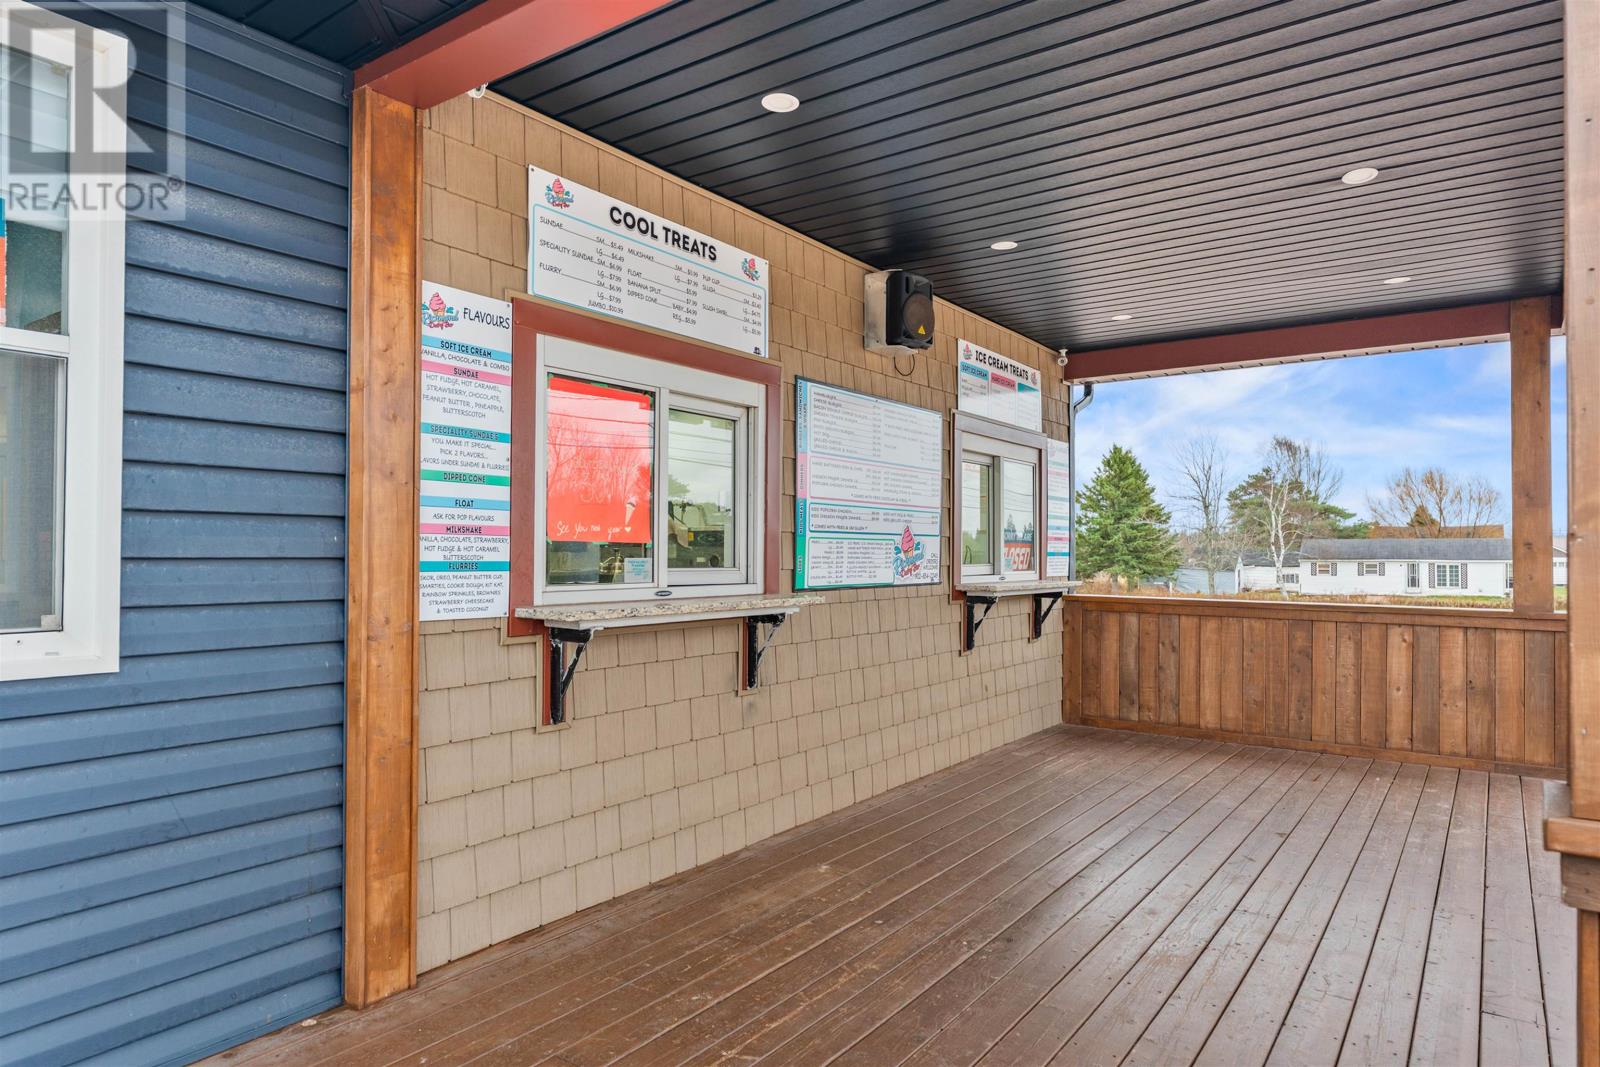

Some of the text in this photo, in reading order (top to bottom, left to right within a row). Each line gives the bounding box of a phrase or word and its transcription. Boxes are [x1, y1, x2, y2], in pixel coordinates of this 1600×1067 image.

[540, 216, 563, 229] SUNDAE
[609, 206, 717, 261] COOL TREATS
[540, 262, 562, 274] FLURRY
[627, 269, 642, 279] FLOAT
[463, 307, 511, 330] FLAVOURS
[440, 340, 492, 358] SOFT ICE CREAM
[447, 353, 482, 366] CHOCOLATE
[490, 363, 510, 371] COMBO
[975, 350, 987, 365] ICE
[988, 355, 1009, 373] CREAM
[1009, 364, 1029, 381] TREATS
[425, 373, 438, 381] HOT
[453, 367, 479, 379] SUNDAE
[423, 393, 447, 404] PEANUT
[443, 407, 486, 419] BUTTERSCOTCH
[430, 424, 468, 436] SPECIALITY
[446, 439, 462, 447] MAKE
[443, 472, 486, 483] DIPPED CONE
[455, 500, 474, 508] FLOAT
[446, 526, 482, 534] MILKSHAKE
[556, 520, 570, 536] See
[437, 545, 456, 554] FUDGE
[449, 562, 479, 570] FLURRIES
[464, 598, 495, 606] CHEESECAKE
